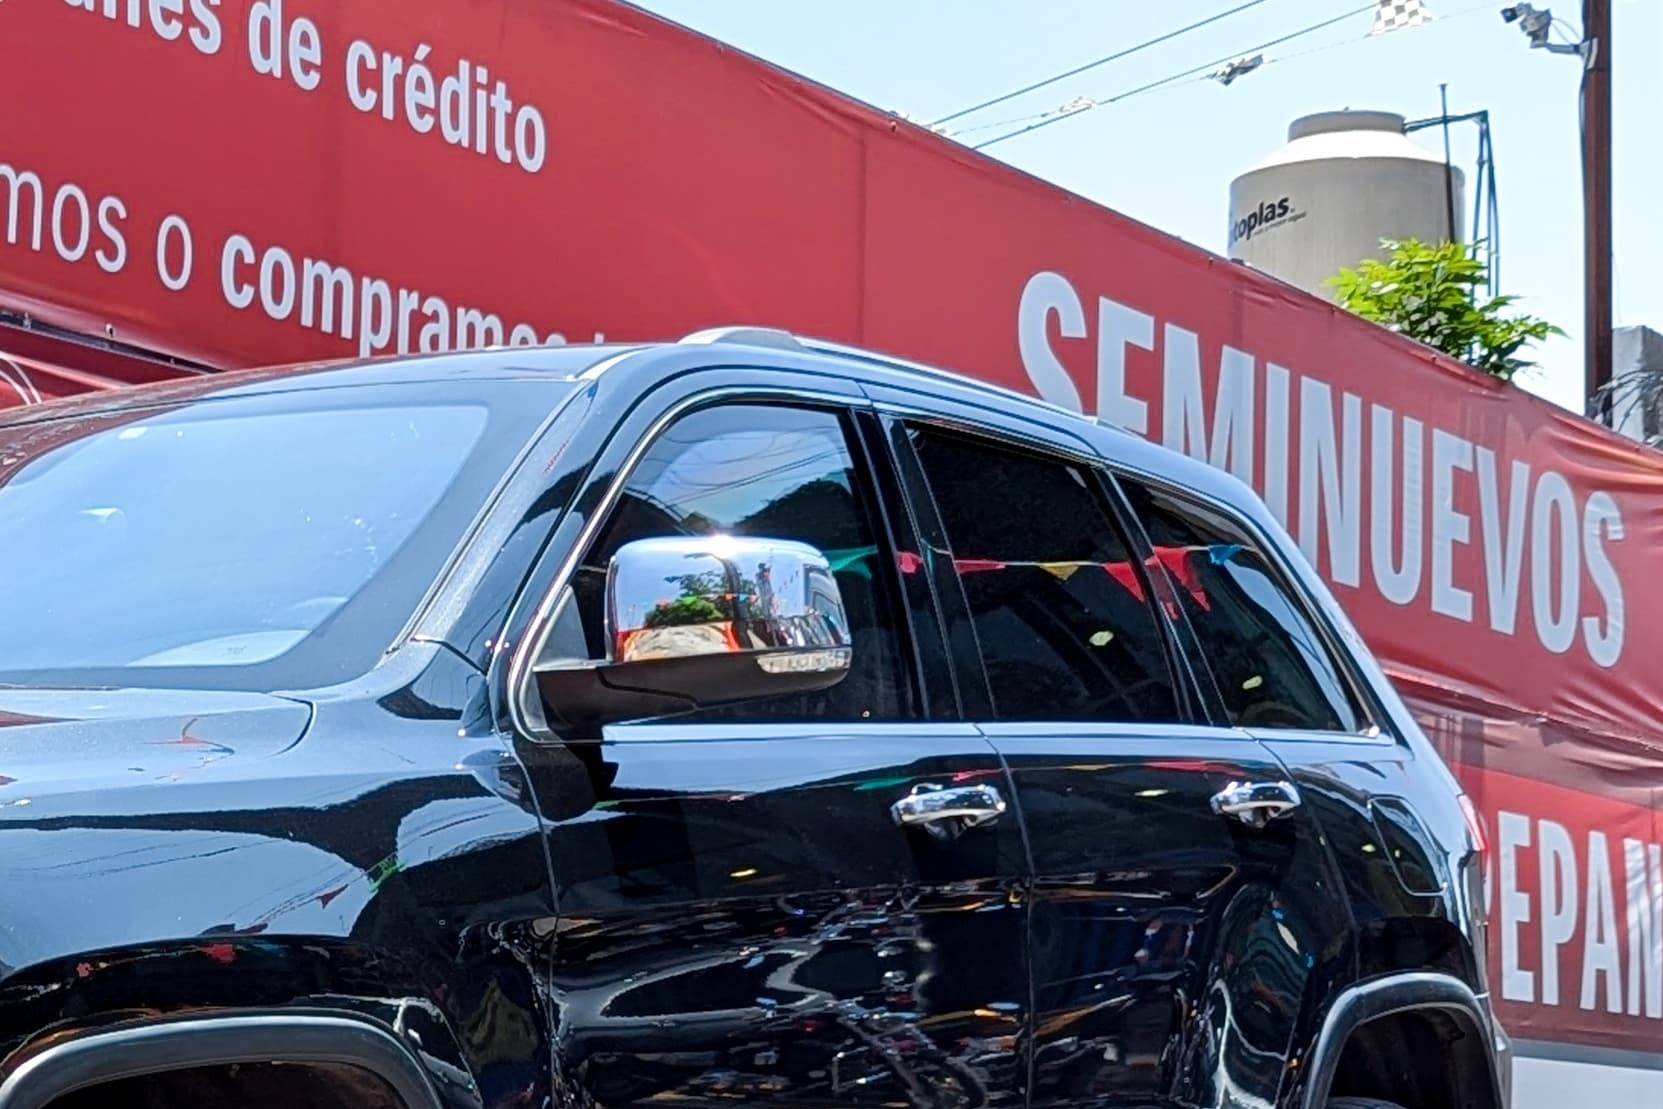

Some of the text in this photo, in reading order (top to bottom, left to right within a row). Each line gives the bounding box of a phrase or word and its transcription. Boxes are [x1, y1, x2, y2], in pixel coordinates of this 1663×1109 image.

[248, 0, 322, 91] de
[346, 43, 546, 173] crédito
[156, 214, 193, 290] o
[222, 234, 567, 358] compram
[1018, 271, 1625, 668] SEMINUEVOS
